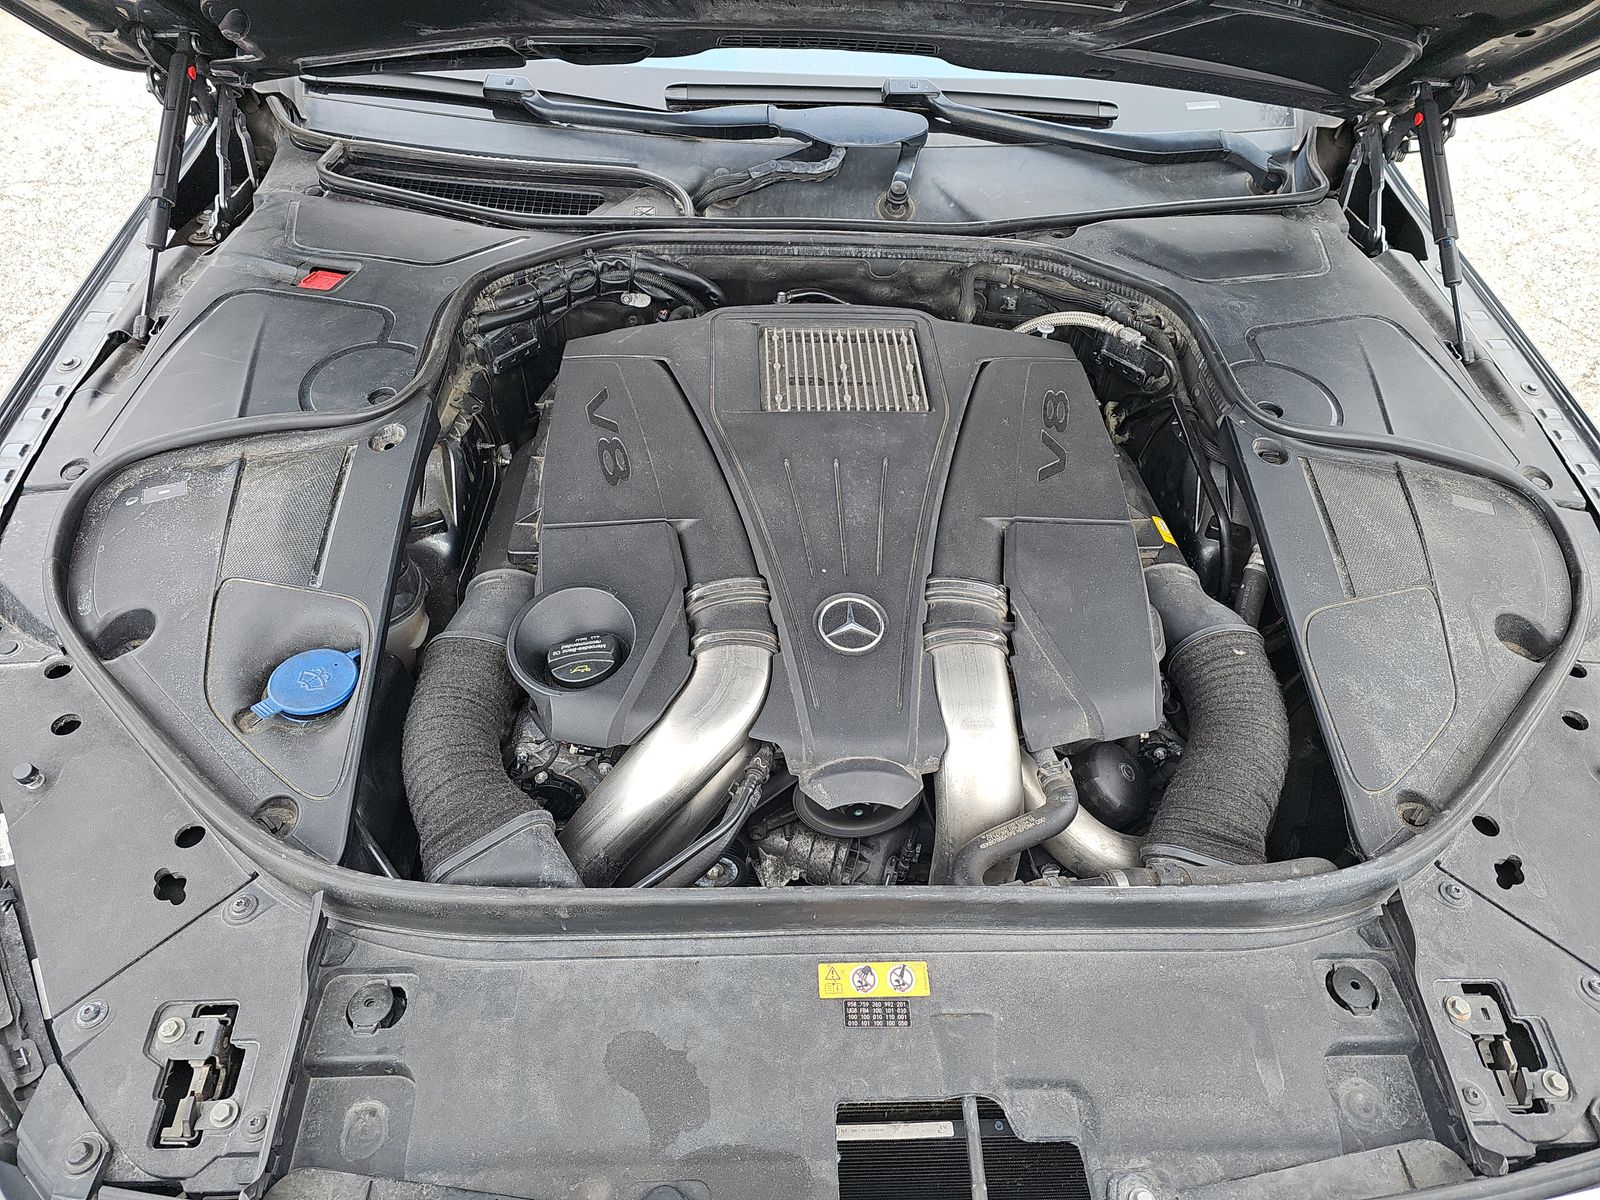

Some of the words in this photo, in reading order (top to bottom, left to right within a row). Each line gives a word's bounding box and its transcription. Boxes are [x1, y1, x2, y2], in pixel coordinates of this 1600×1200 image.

[585, 385, 631, 487] V8
[1037, 389, 1070, 482] V8
[561, 640, 602, 650] recommended
[562, 643, 607, 654] Mercedes-Benz
